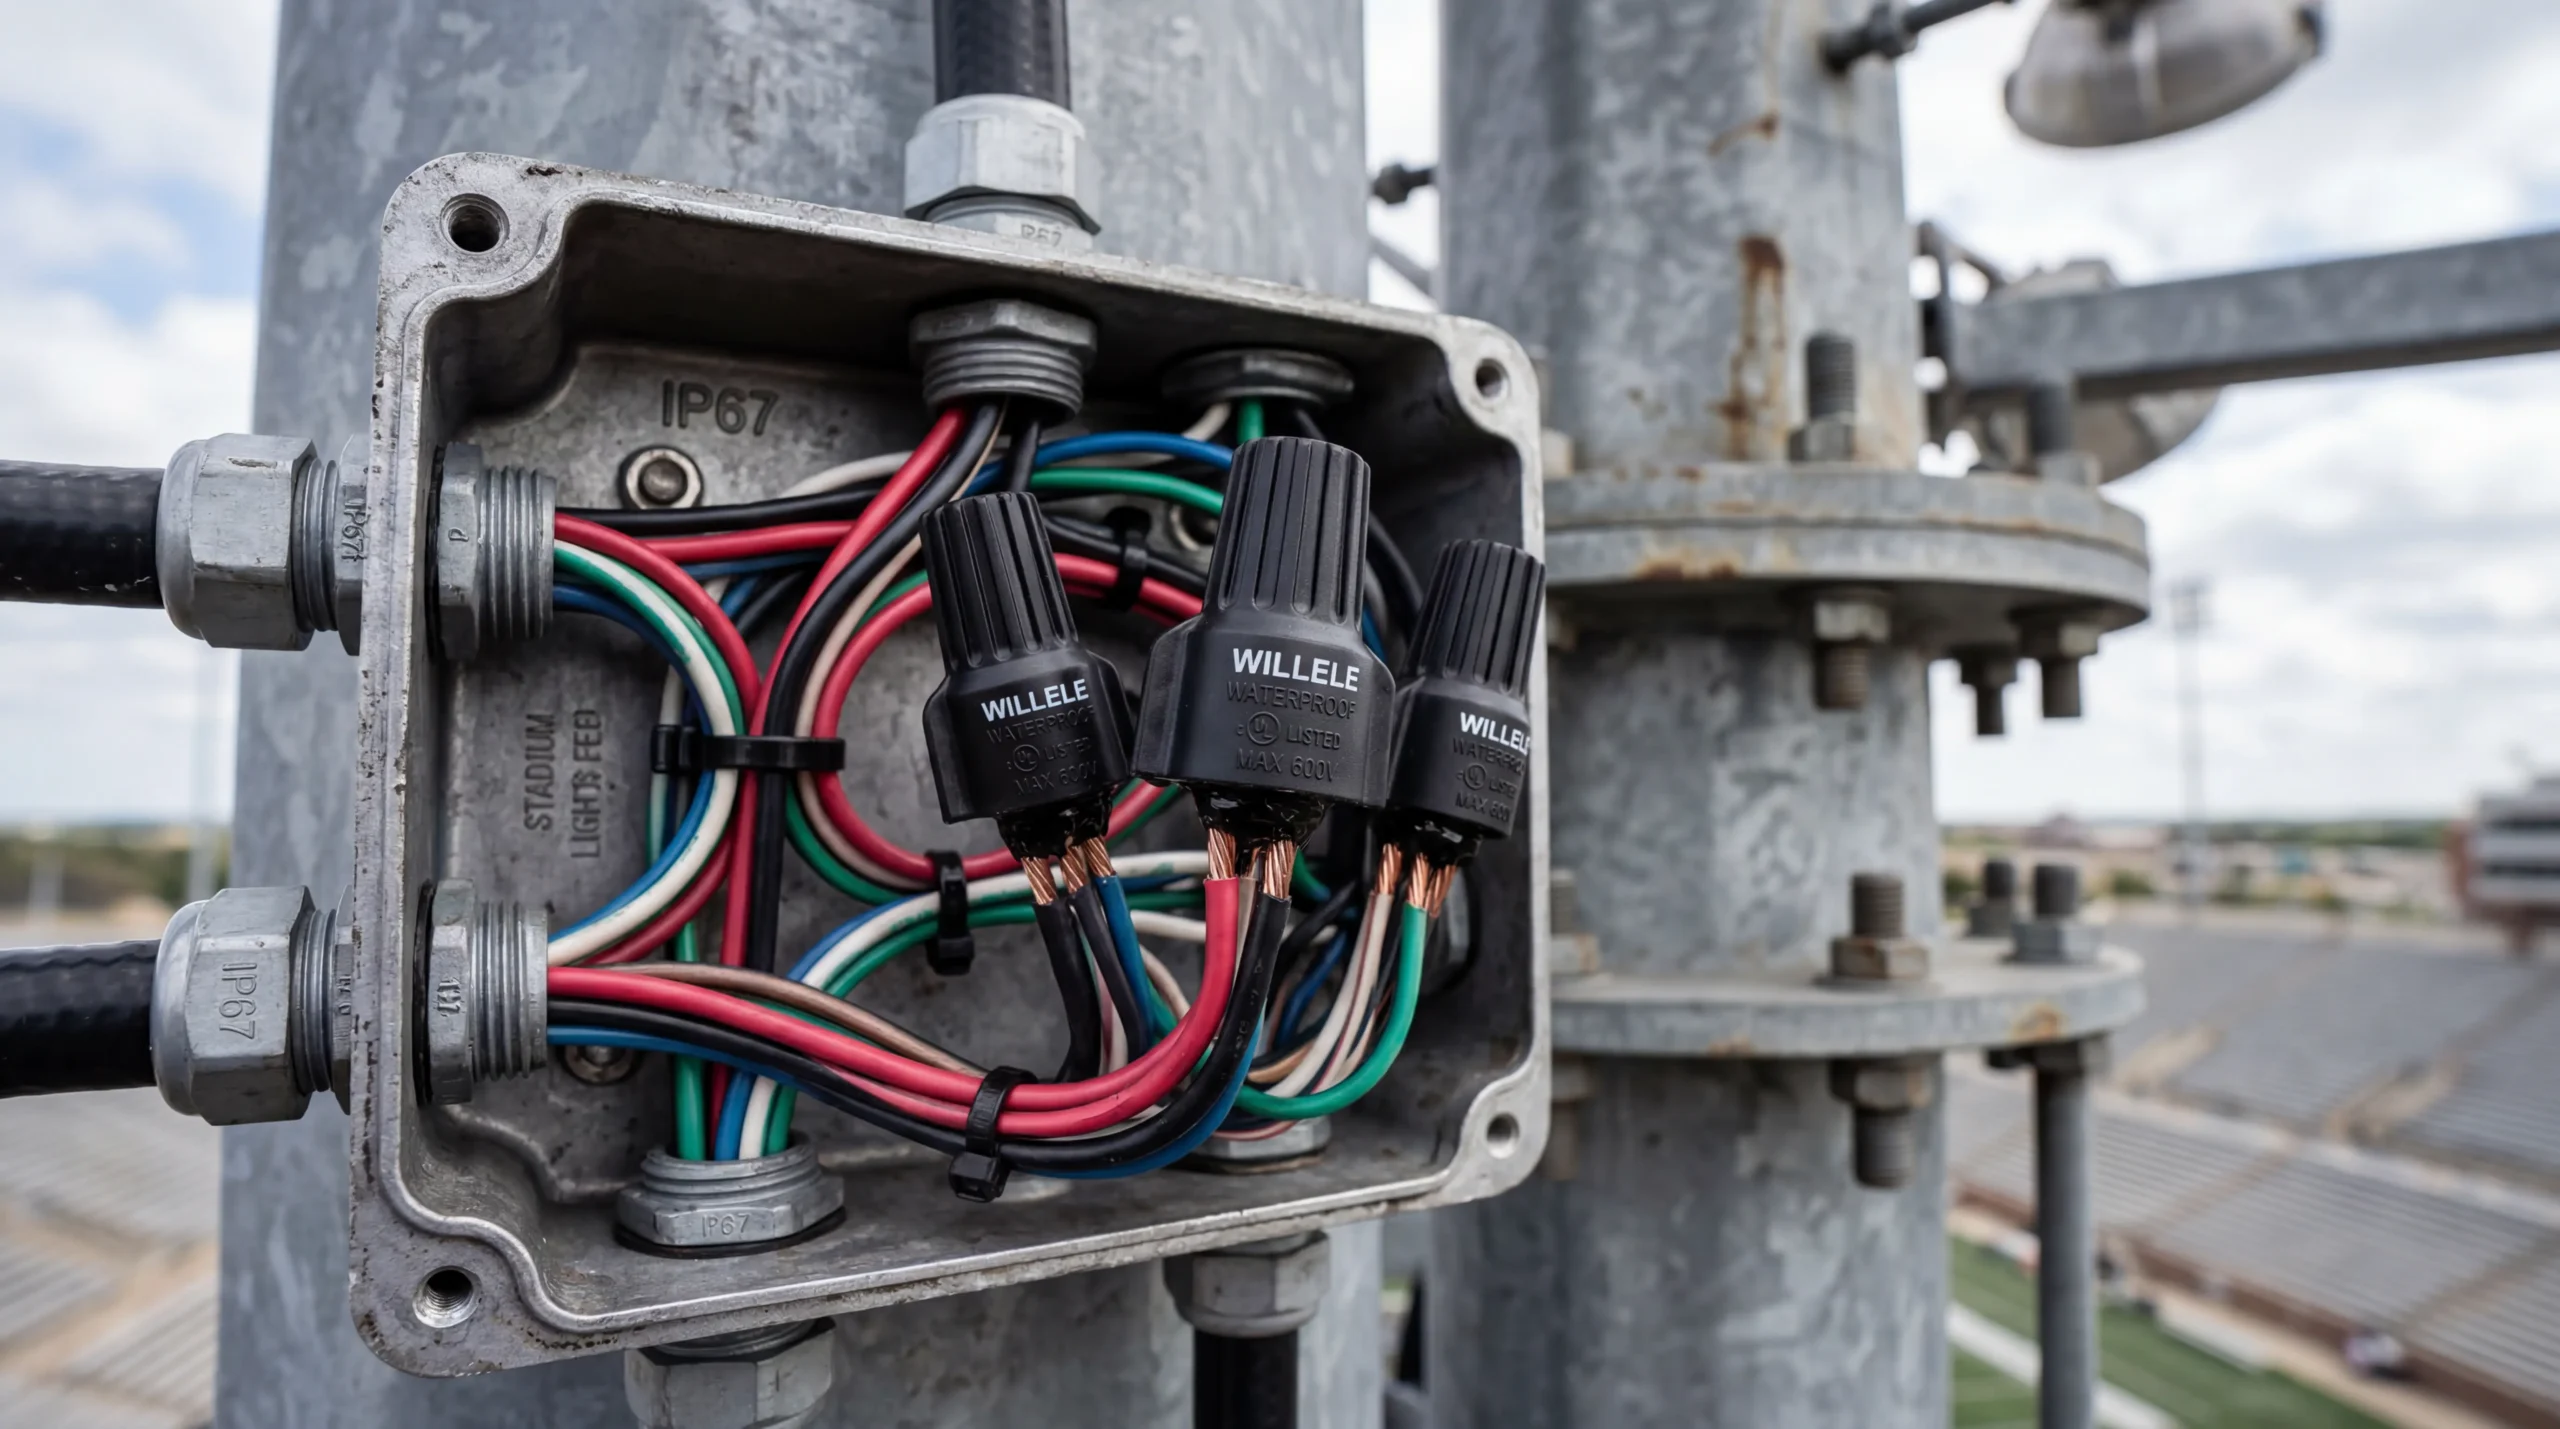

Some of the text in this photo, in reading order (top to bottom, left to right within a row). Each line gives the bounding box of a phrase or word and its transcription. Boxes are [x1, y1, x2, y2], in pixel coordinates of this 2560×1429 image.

[662, 379, 780, 437] IP67
[1233, 648, 1360, 692] WILLELE
[981, 679, 1089, 722] WILLELE
[1226, 681, 1356, 719] WATERPROOF
[1287, 724, 1341, 750] LISTED
[524, 713, 556, 831] STADIUM
[1236, 749, 1339, 782] MAX 600V
[219, 963, 258, 1040] IP67
[702, 1214, 750, 1237] IP67
